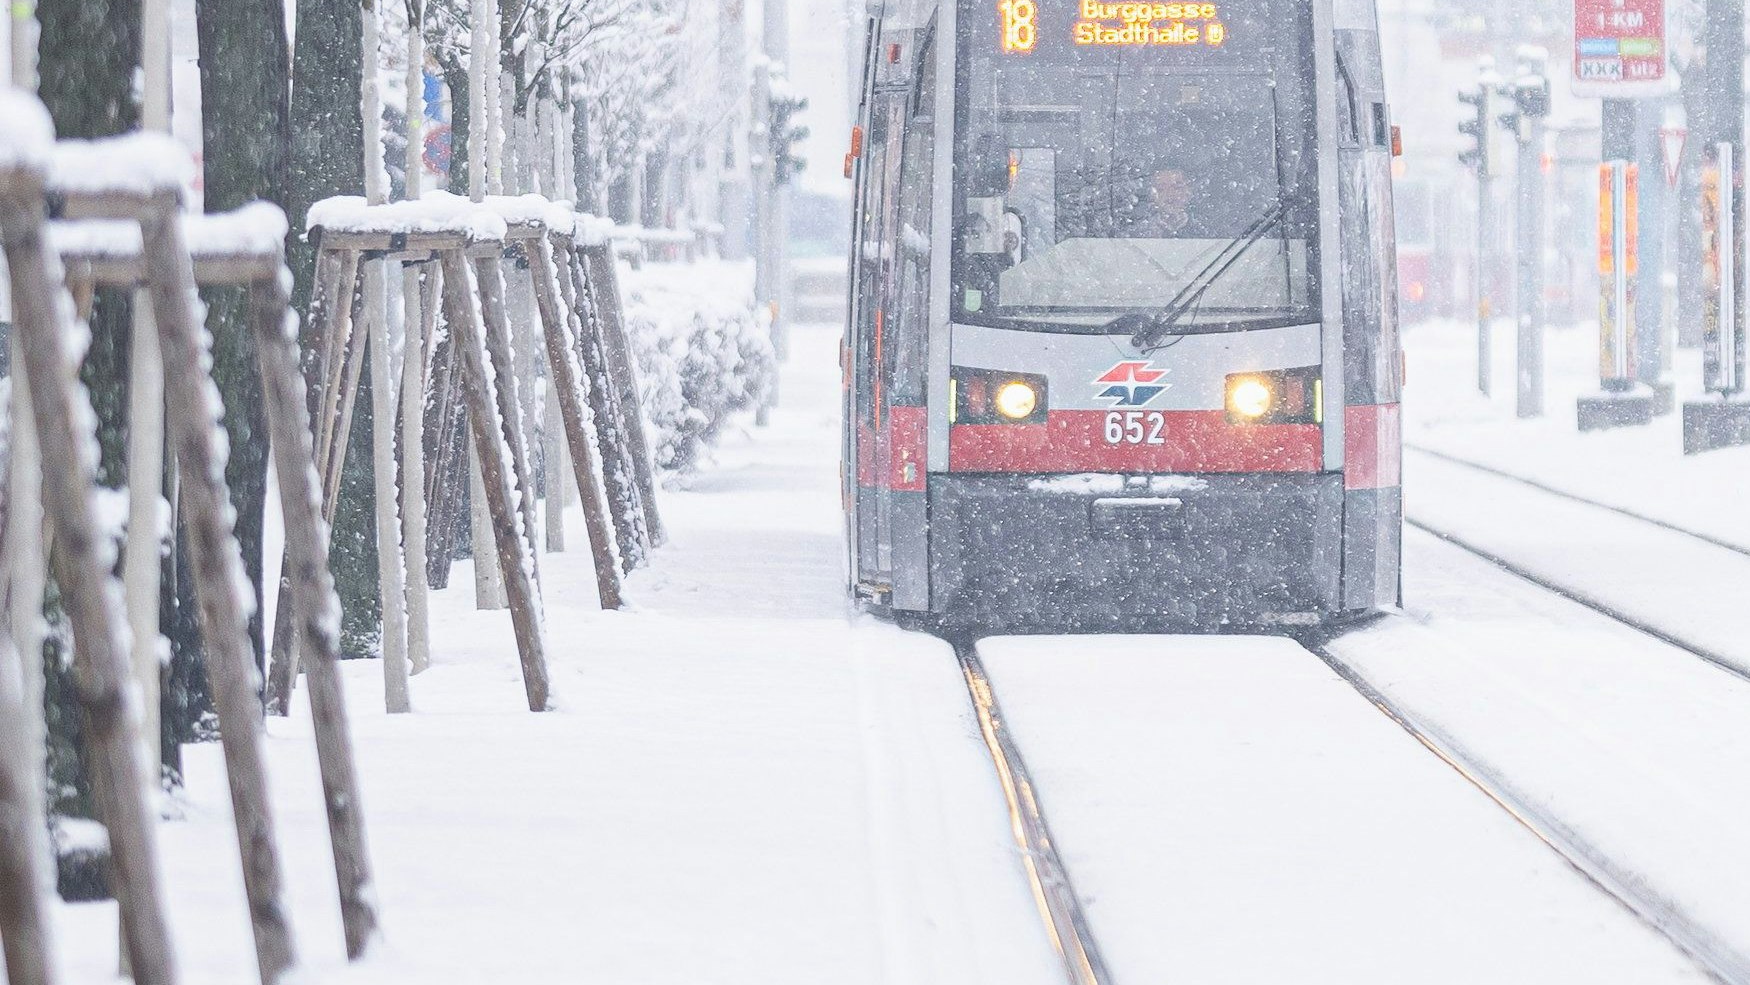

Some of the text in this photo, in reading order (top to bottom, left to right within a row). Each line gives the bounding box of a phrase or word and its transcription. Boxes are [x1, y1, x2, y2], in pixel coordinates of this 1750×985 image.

[1613, 12, 1644, 26] KM
[1076, 22, 1200, 44] Stadthalle
[1105, 411, 1165, 445] 652
